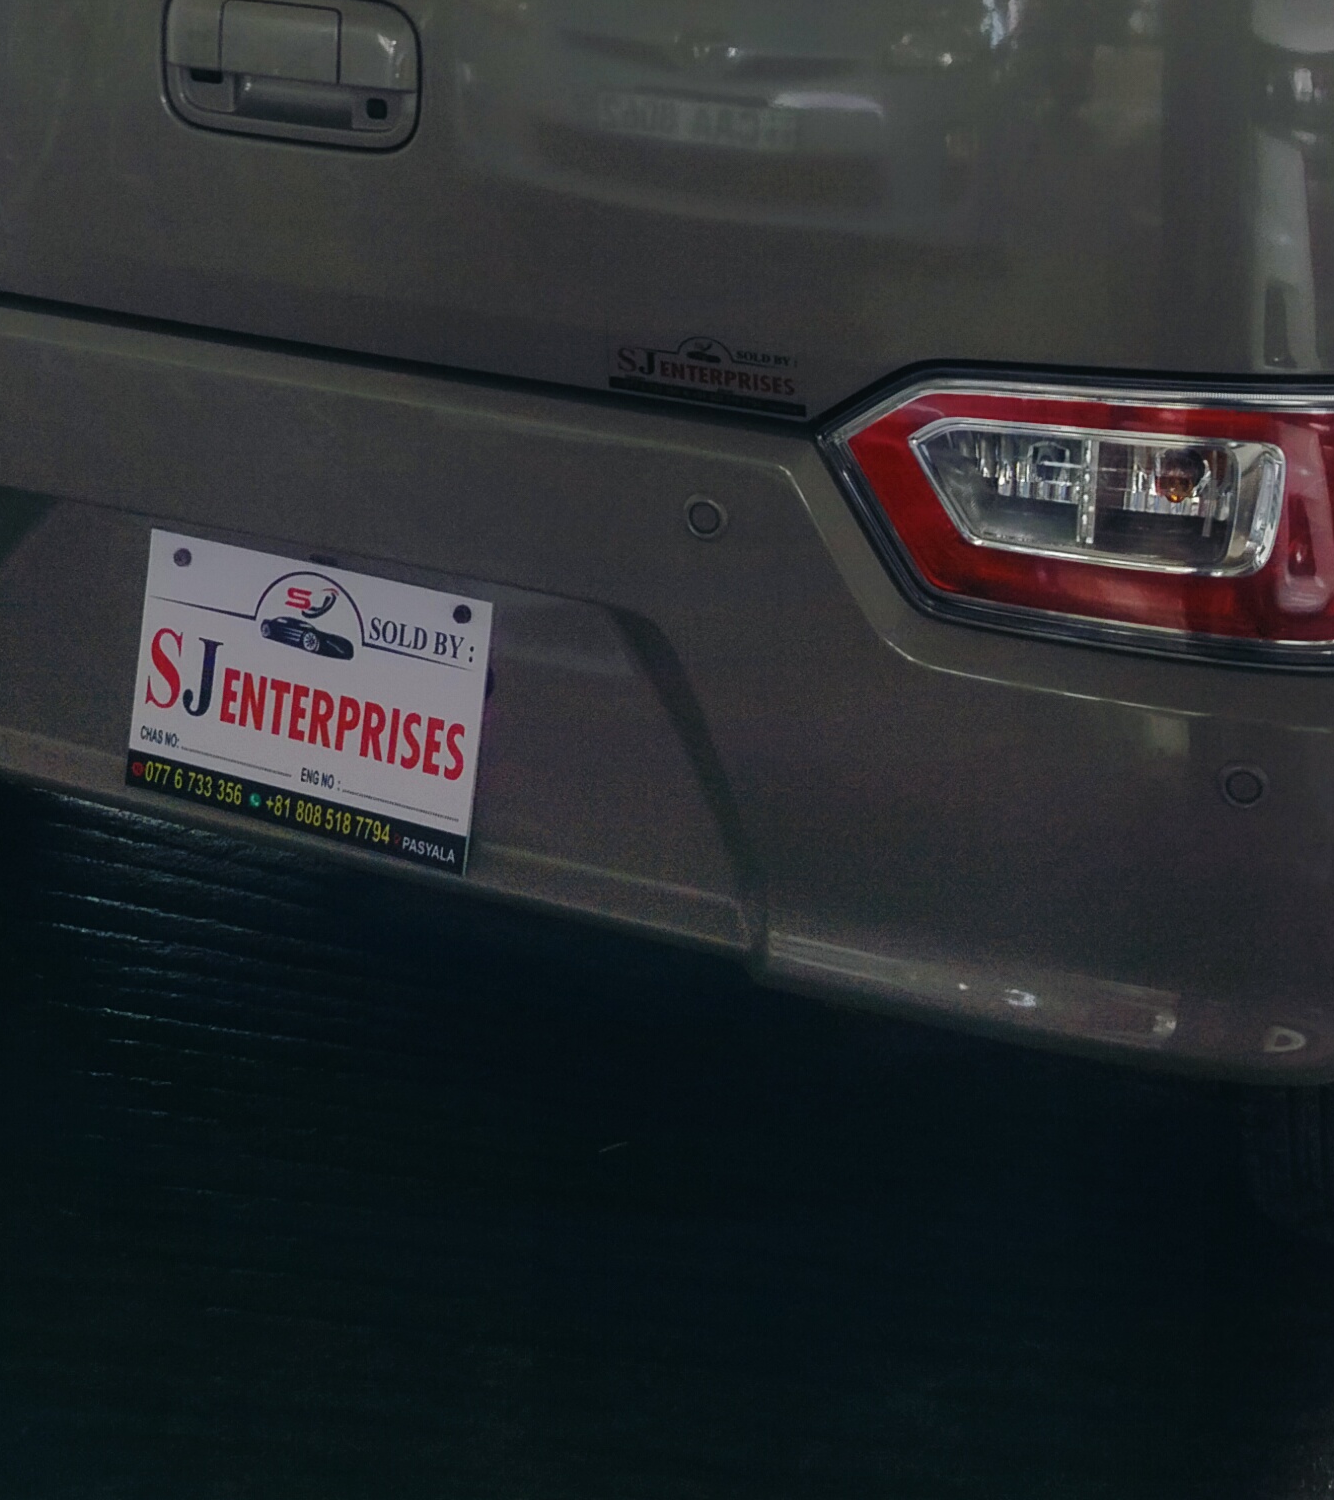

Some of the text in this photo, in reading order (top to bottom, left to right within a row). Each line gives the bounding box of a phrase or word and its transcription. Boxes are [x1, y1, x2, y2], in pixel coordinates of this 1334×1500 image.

[617, 348, 658, 376] SJ
[659, 360, 796, 396] ENTERPRISES
[735, 349, 771, 364] SOLD
[369, 616, 428, 650] SOLD
[145, 627, 466, 781] SJ ENTERPRISES
[140, 725, 164, 745] CHAS
[144, 761, 243, 806] 077 6 733 356
[300, 767, 319, 784] ENG
[266, 794, 390, 845] +81 808 518 7794
[402, 836, 455, 864] PASYALA
